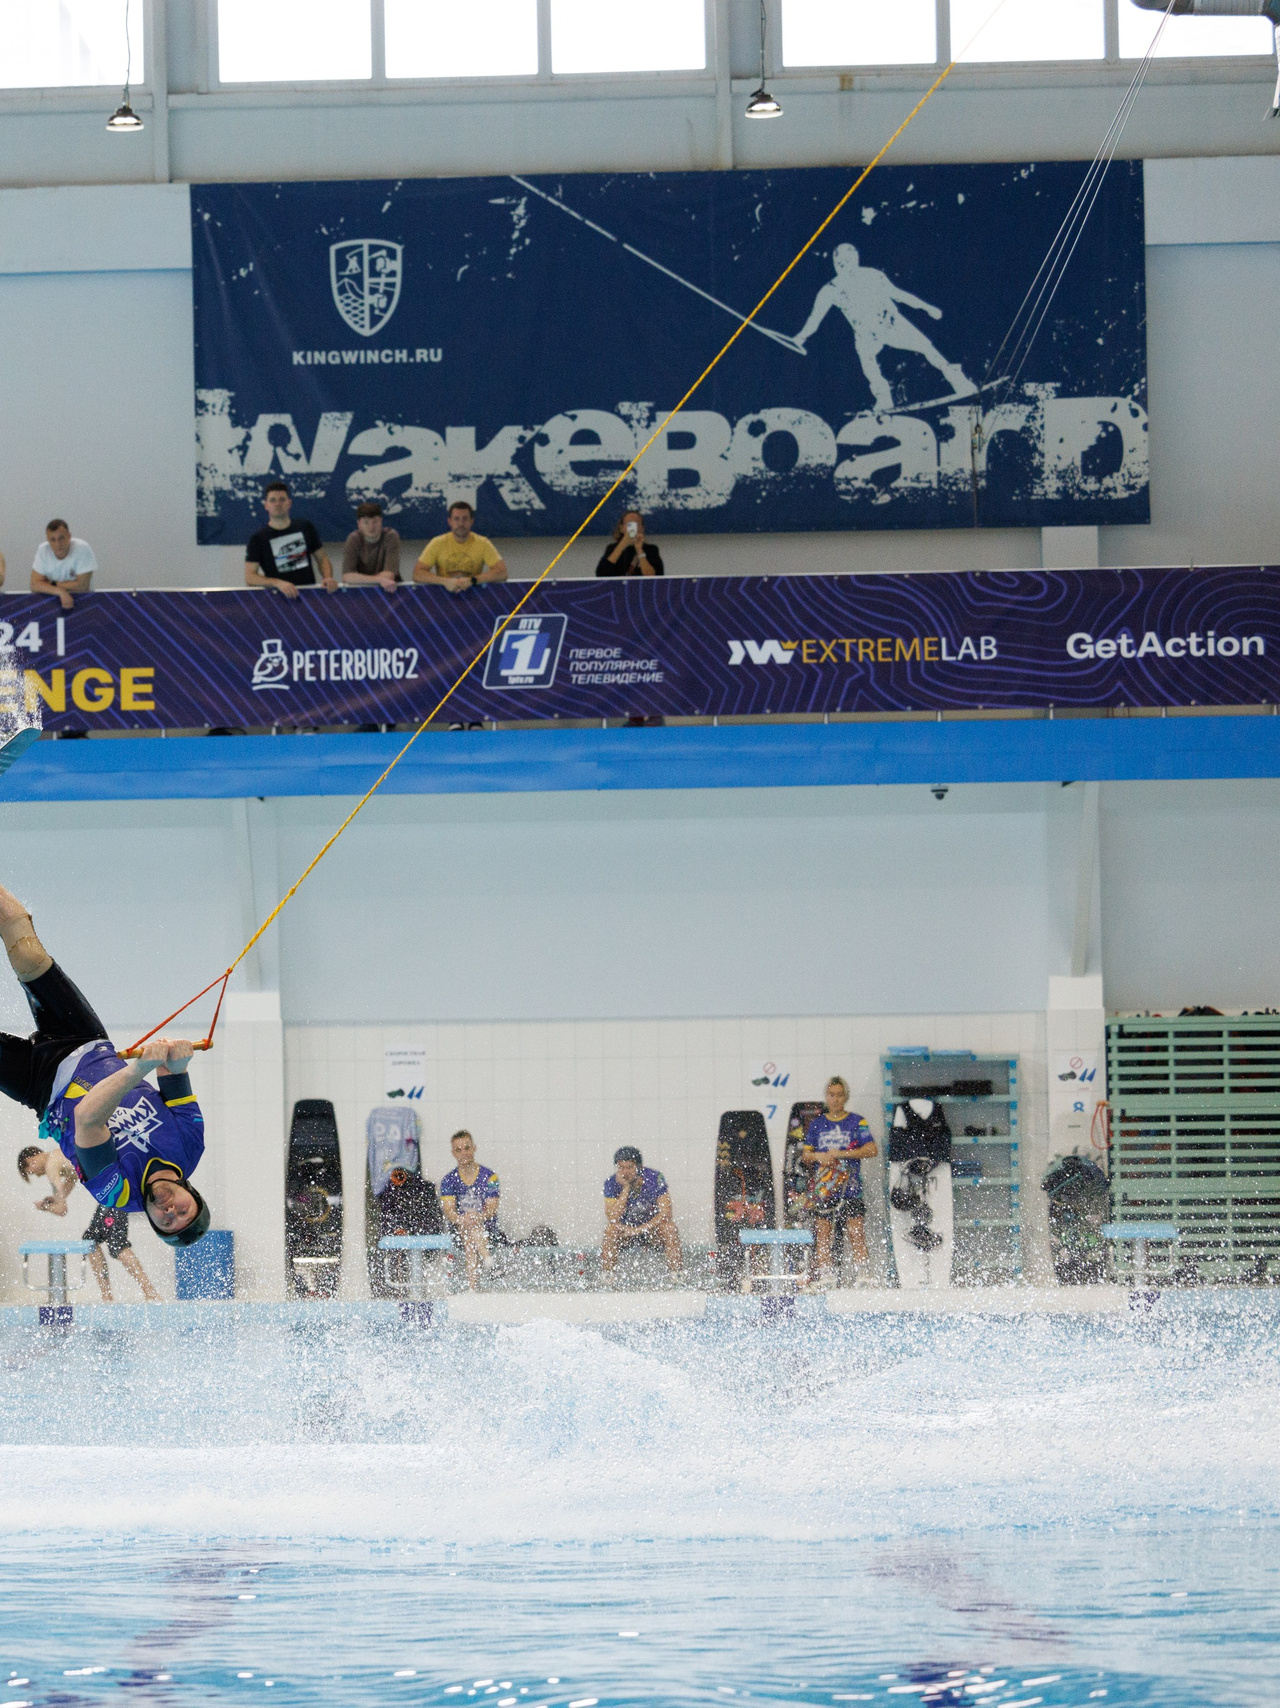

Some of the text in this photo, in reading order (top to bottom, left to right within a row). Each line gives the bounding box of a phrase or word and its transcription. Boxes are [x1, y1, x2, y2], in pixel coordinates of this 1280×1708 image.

[292, 348, 443, 365] KINGWINCH.RU
[570, 647, 622, 659] ПЕРВОЕ
[802, 636, 998, 664] EXTREMELAB
[1066, 631, 1265, 659] GetAction
[293, 647, 419, 681] PETERBURG2
[570, 659, 658, 672] ПОПУЛЯРНОЕ
[571, 672, 664, 685] ТЕЛЕВИДЕНИЕ
[766, 1104, 778, 1119] 7
